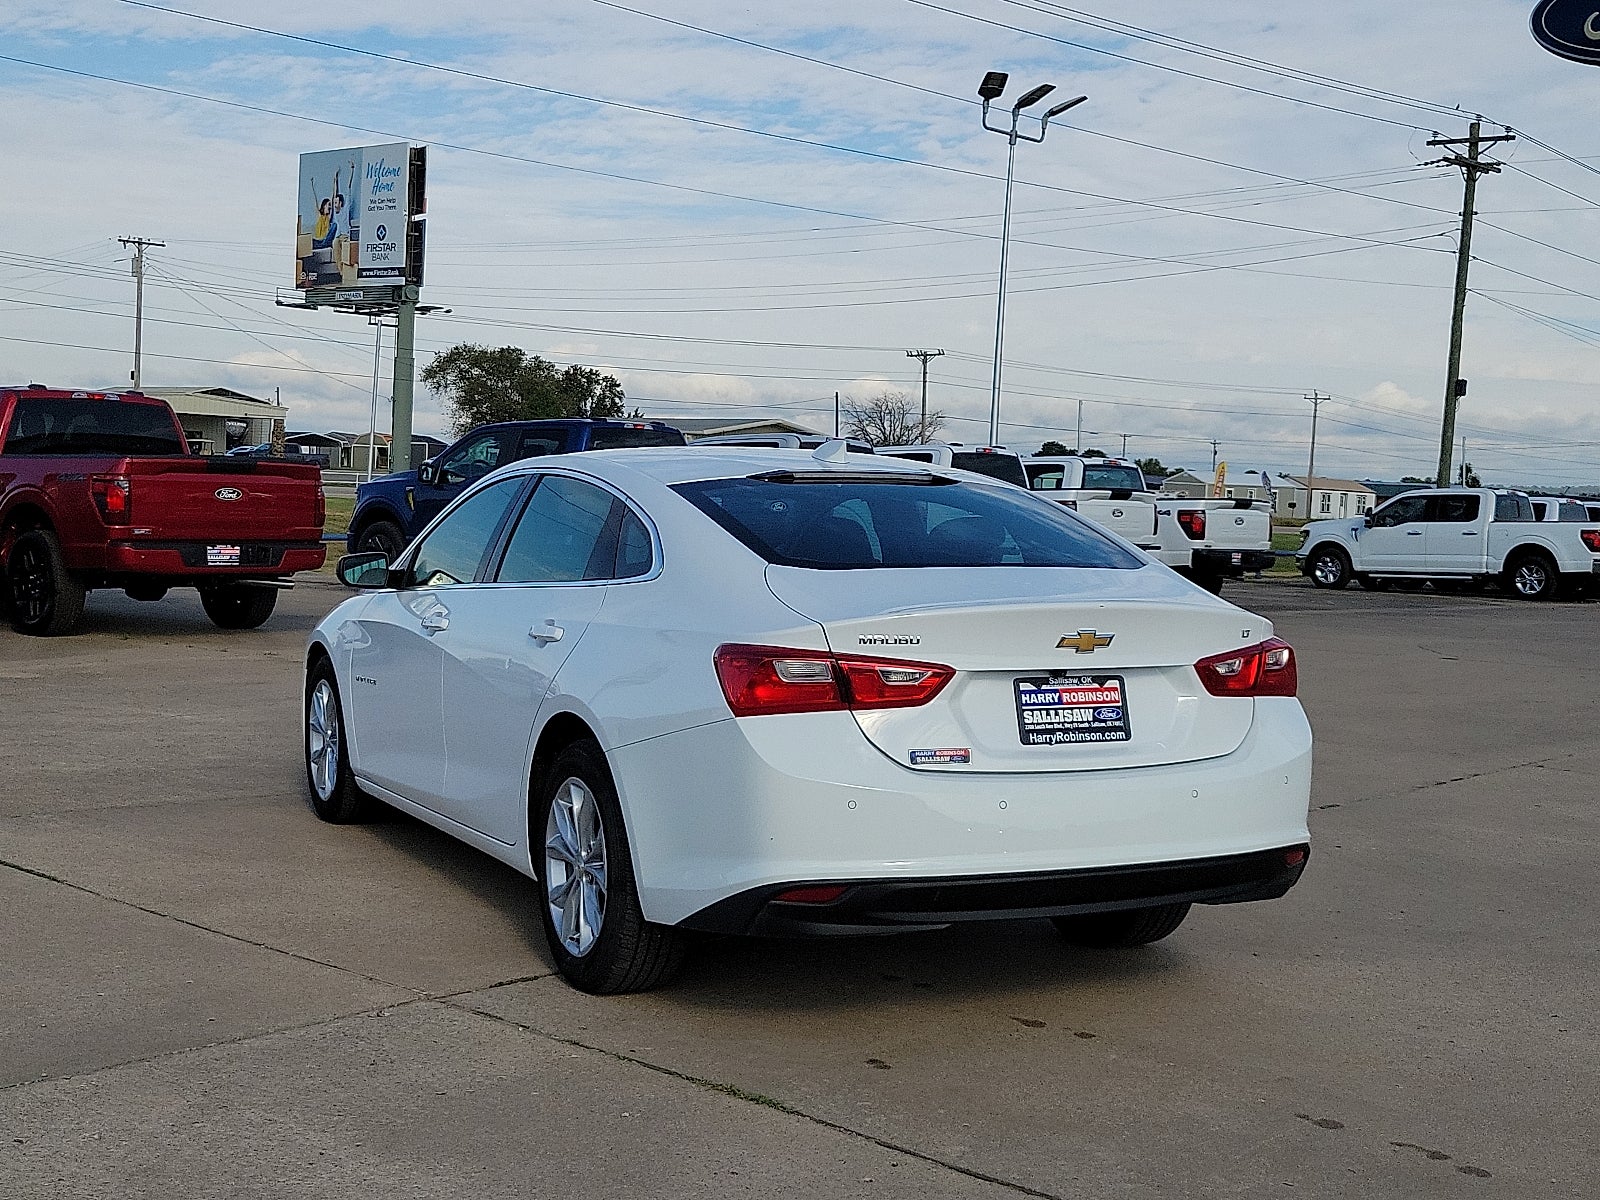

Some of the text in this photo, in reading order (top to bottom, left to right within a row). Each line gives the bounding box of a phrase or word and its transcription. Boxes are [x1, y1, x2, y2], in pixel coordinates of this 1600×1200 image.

[366, 158, 400, 178] Welcome
[372, 178, 394, 195] Home
[366, 243, 396, 252] FIRSTAR
[371, 252, 390, 261] BANK
[858, 634, 922, 645] MALIBU
[1081, 676, 1093, 684] OK
[1022, 691, 1120, 704] HARRY ROBINSON
[1023, 709, 1093, 723] SALLISAW
[1029, 731, 1126, 744] HarryRobinson.com
